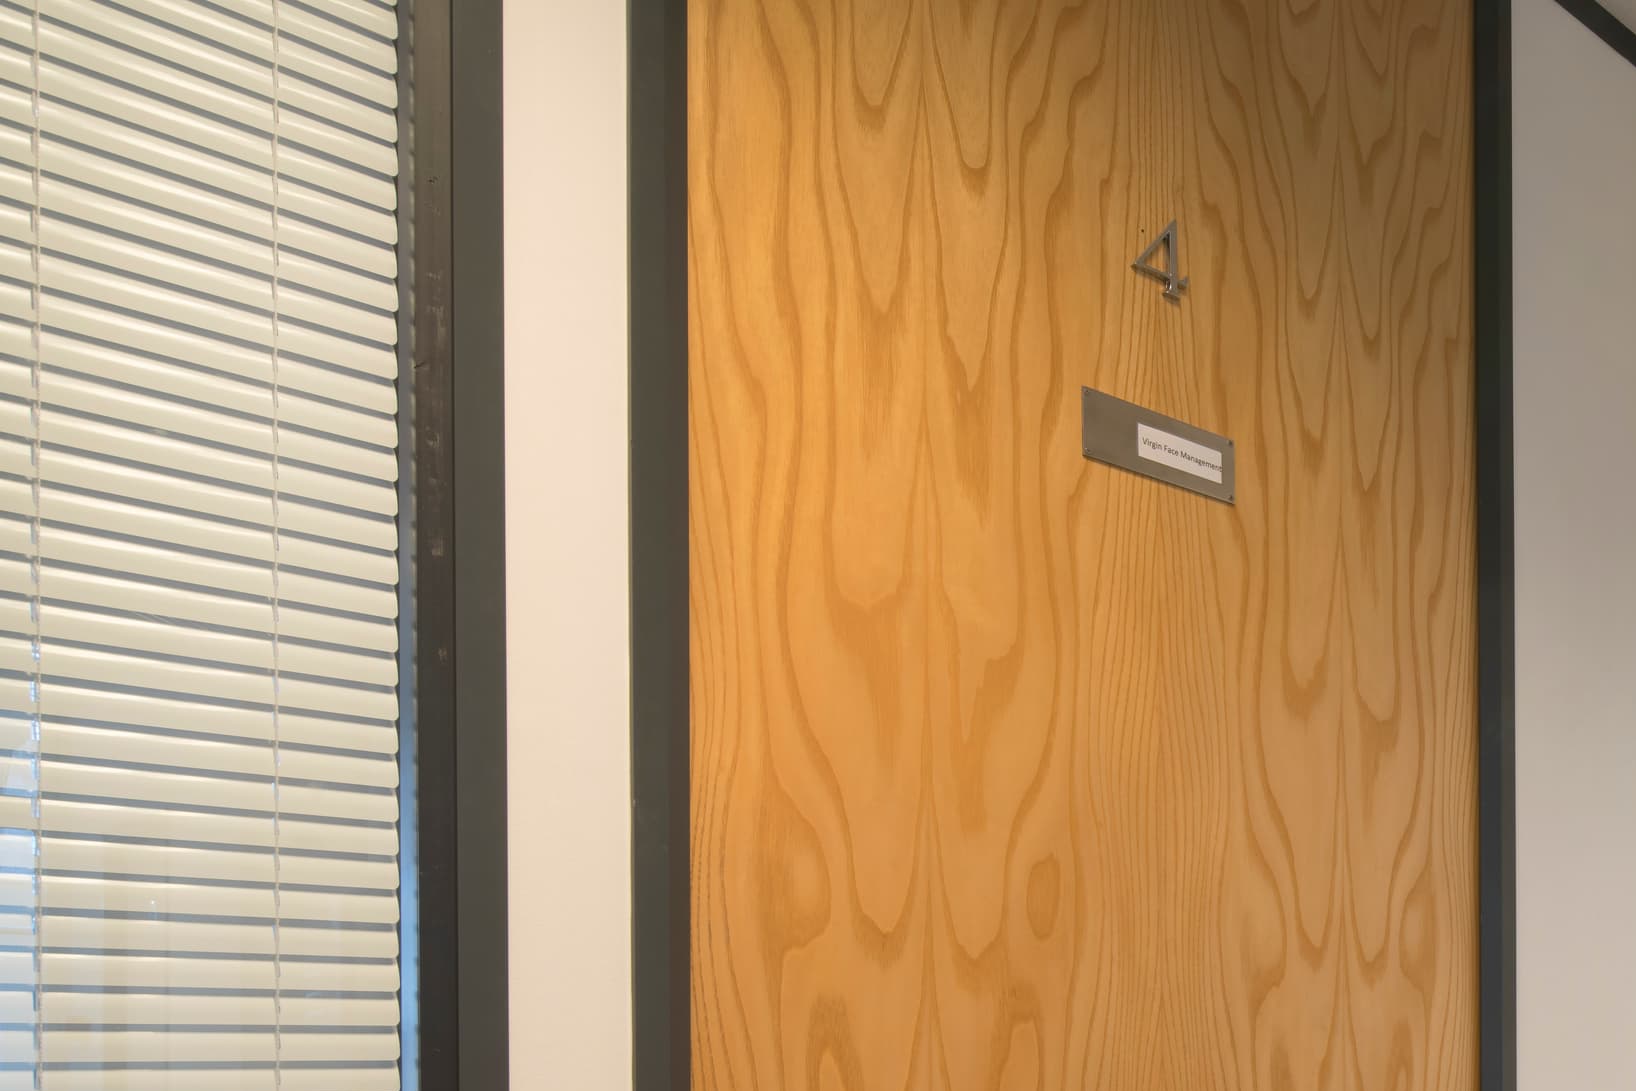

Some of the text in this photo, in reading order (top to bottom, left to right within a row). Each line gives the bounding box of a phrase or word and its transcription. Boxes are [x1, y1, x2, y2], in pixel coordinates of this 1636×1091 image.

[1131, 218, 1188, 302] 4
[1142, 436, 1163, 451] Virgin
[1163, 444, 1180, 457] Face
